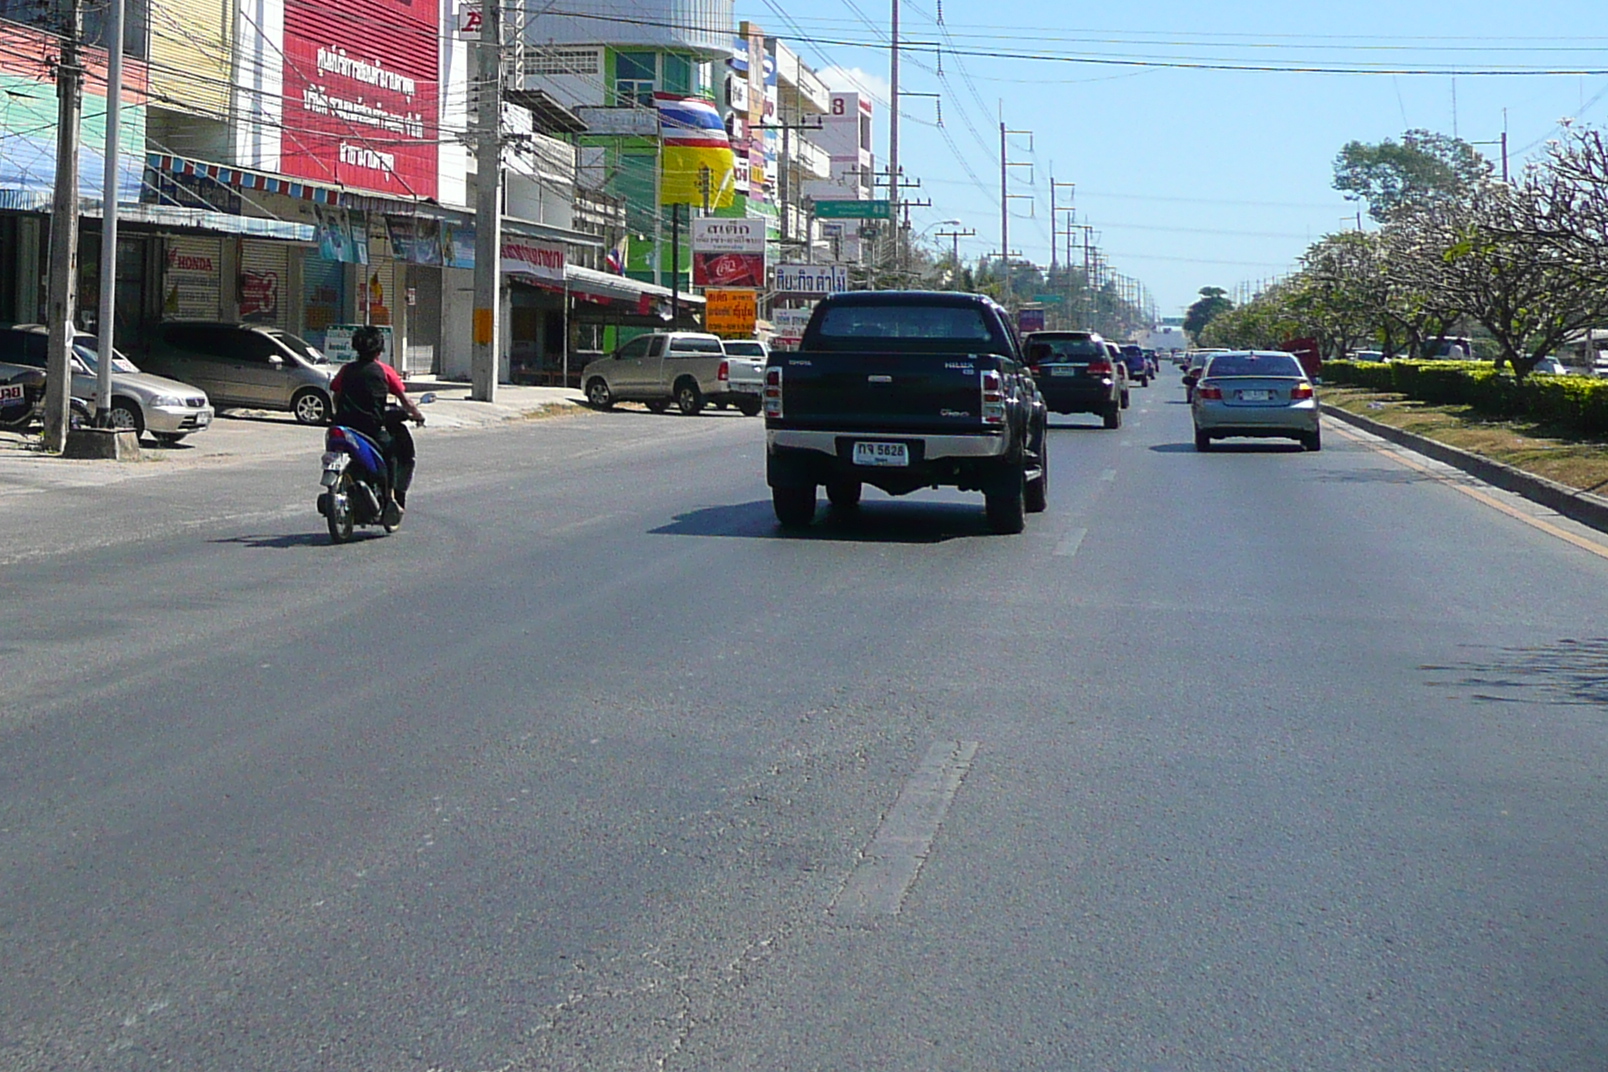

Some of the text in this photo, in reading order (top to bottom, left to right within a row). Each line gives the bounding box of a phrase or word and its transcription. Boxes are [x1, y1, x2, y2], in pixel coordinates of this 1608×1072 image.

[177, 255, 213, 271] HONDA
[776, 265, 846, 292] ติยะกิจ ค้าไม้
